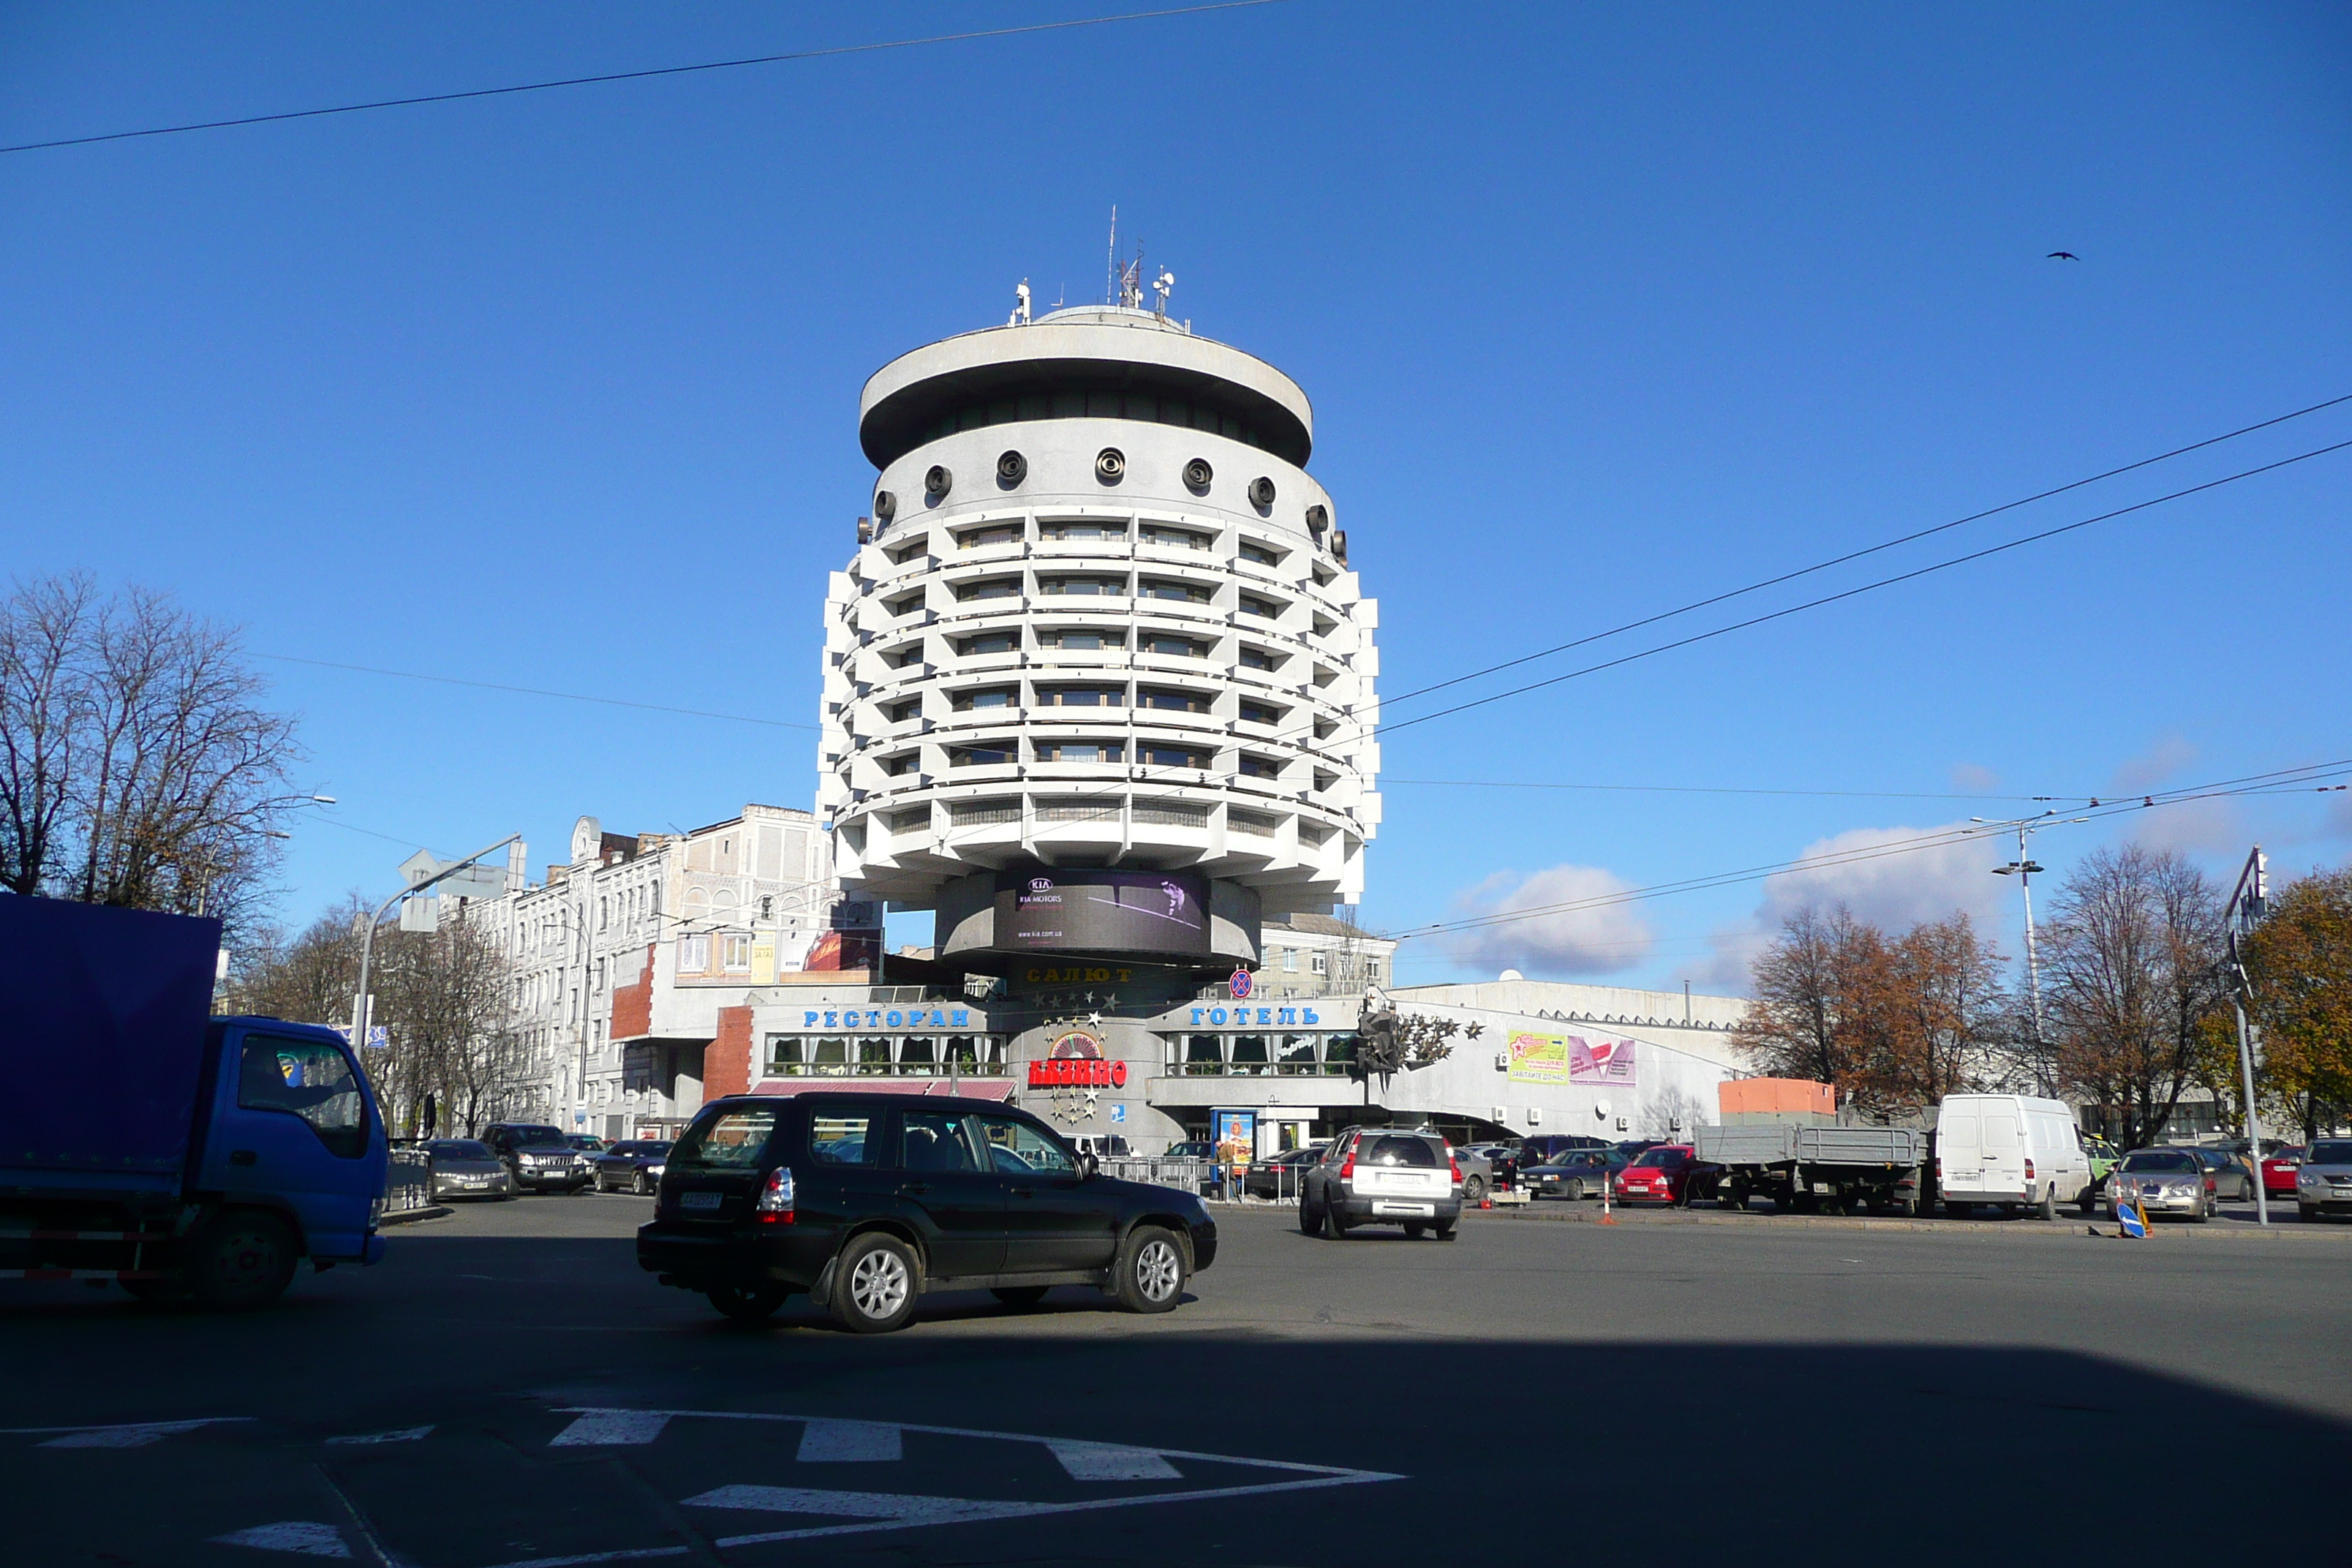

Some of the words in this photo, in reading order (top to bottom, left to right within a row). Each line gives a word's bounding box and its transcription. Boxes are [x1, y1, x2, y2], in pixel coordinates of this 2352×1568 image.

[1033, 895, 1062, 903] MOTORS
[1017, 930, 1062, 938] www.kia.com.ua
[1027, 968, 1132, 983] САЛЮТ
[804, 1010, 969, 1028] РЕСТОРАН
[1191, 1008, 1320, 1025] ГОТЕЛЬ
[1028, 1060, 1127, 1085] КАЗИНО
[1542, 1073, 1551, 1081] ДО
